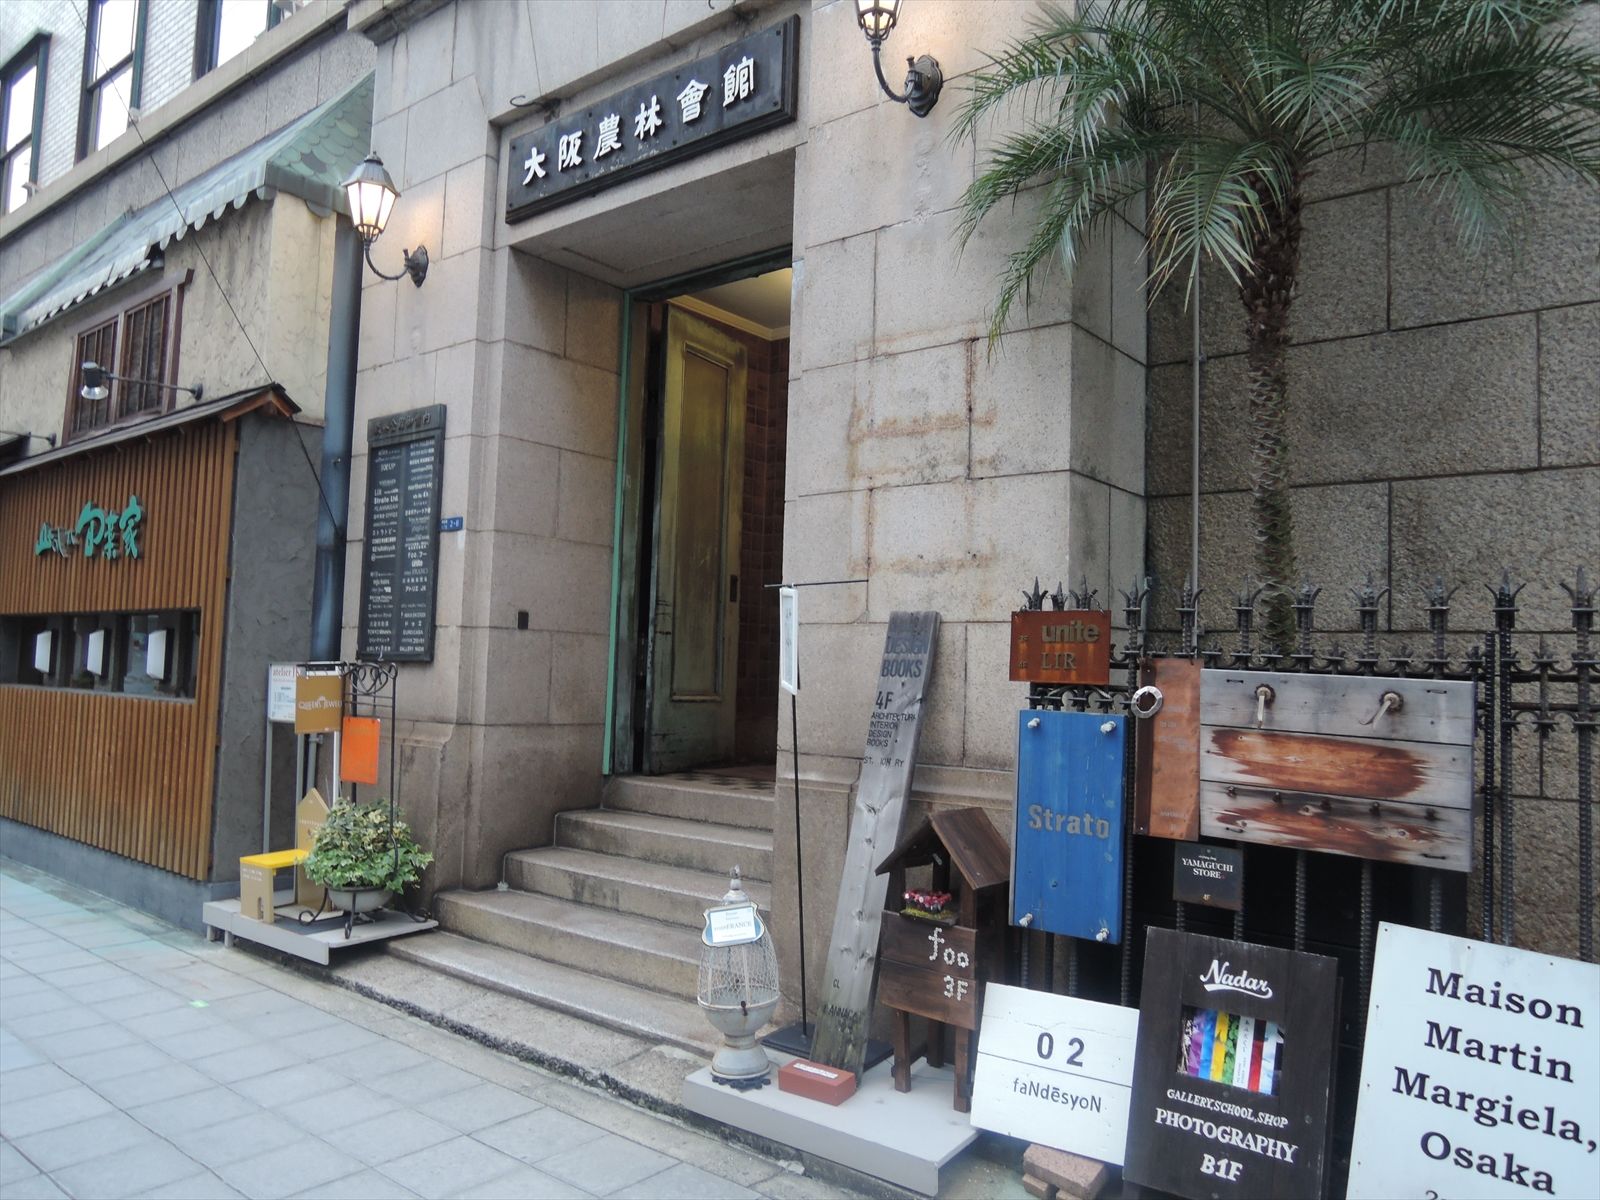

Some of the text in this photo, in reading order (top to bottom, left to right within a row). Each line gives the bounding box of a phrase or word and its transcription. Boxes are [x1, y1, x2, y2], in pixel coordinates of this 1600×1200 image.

[522, 56, 755, 187] 大阪農林會館
[885, 640, 928, 655] DESIGN
[1041, 619, 1099, 644] unite
[881, 659, 923, 678] BOOKS
[1041, 652, 1077, 670] LIR
[875, 690, 894, 710] 4F
[1027, 804, 1111, 840] Strato
[1181, 857, 1234, 873] YAMAGUCHI
[1193, 867, 1221, 879] STORE
[928, 927, 969, 968] foo
[943, 975, 968, 1001] 3F
[1200, 959, 1273, 999] Nadar
[1425, 967, 1584, 1029] Maison
[1424, 1020, 1574, 1083] Martin
[1392, 1066, 1597, 1153] Margiela,
[1154, 1107, 1299, 1164] PHOTOGRAPHY
[1200, 1153, 1243, 1181] B1F
[1420, 1131, 1555, 1195] Osaka
